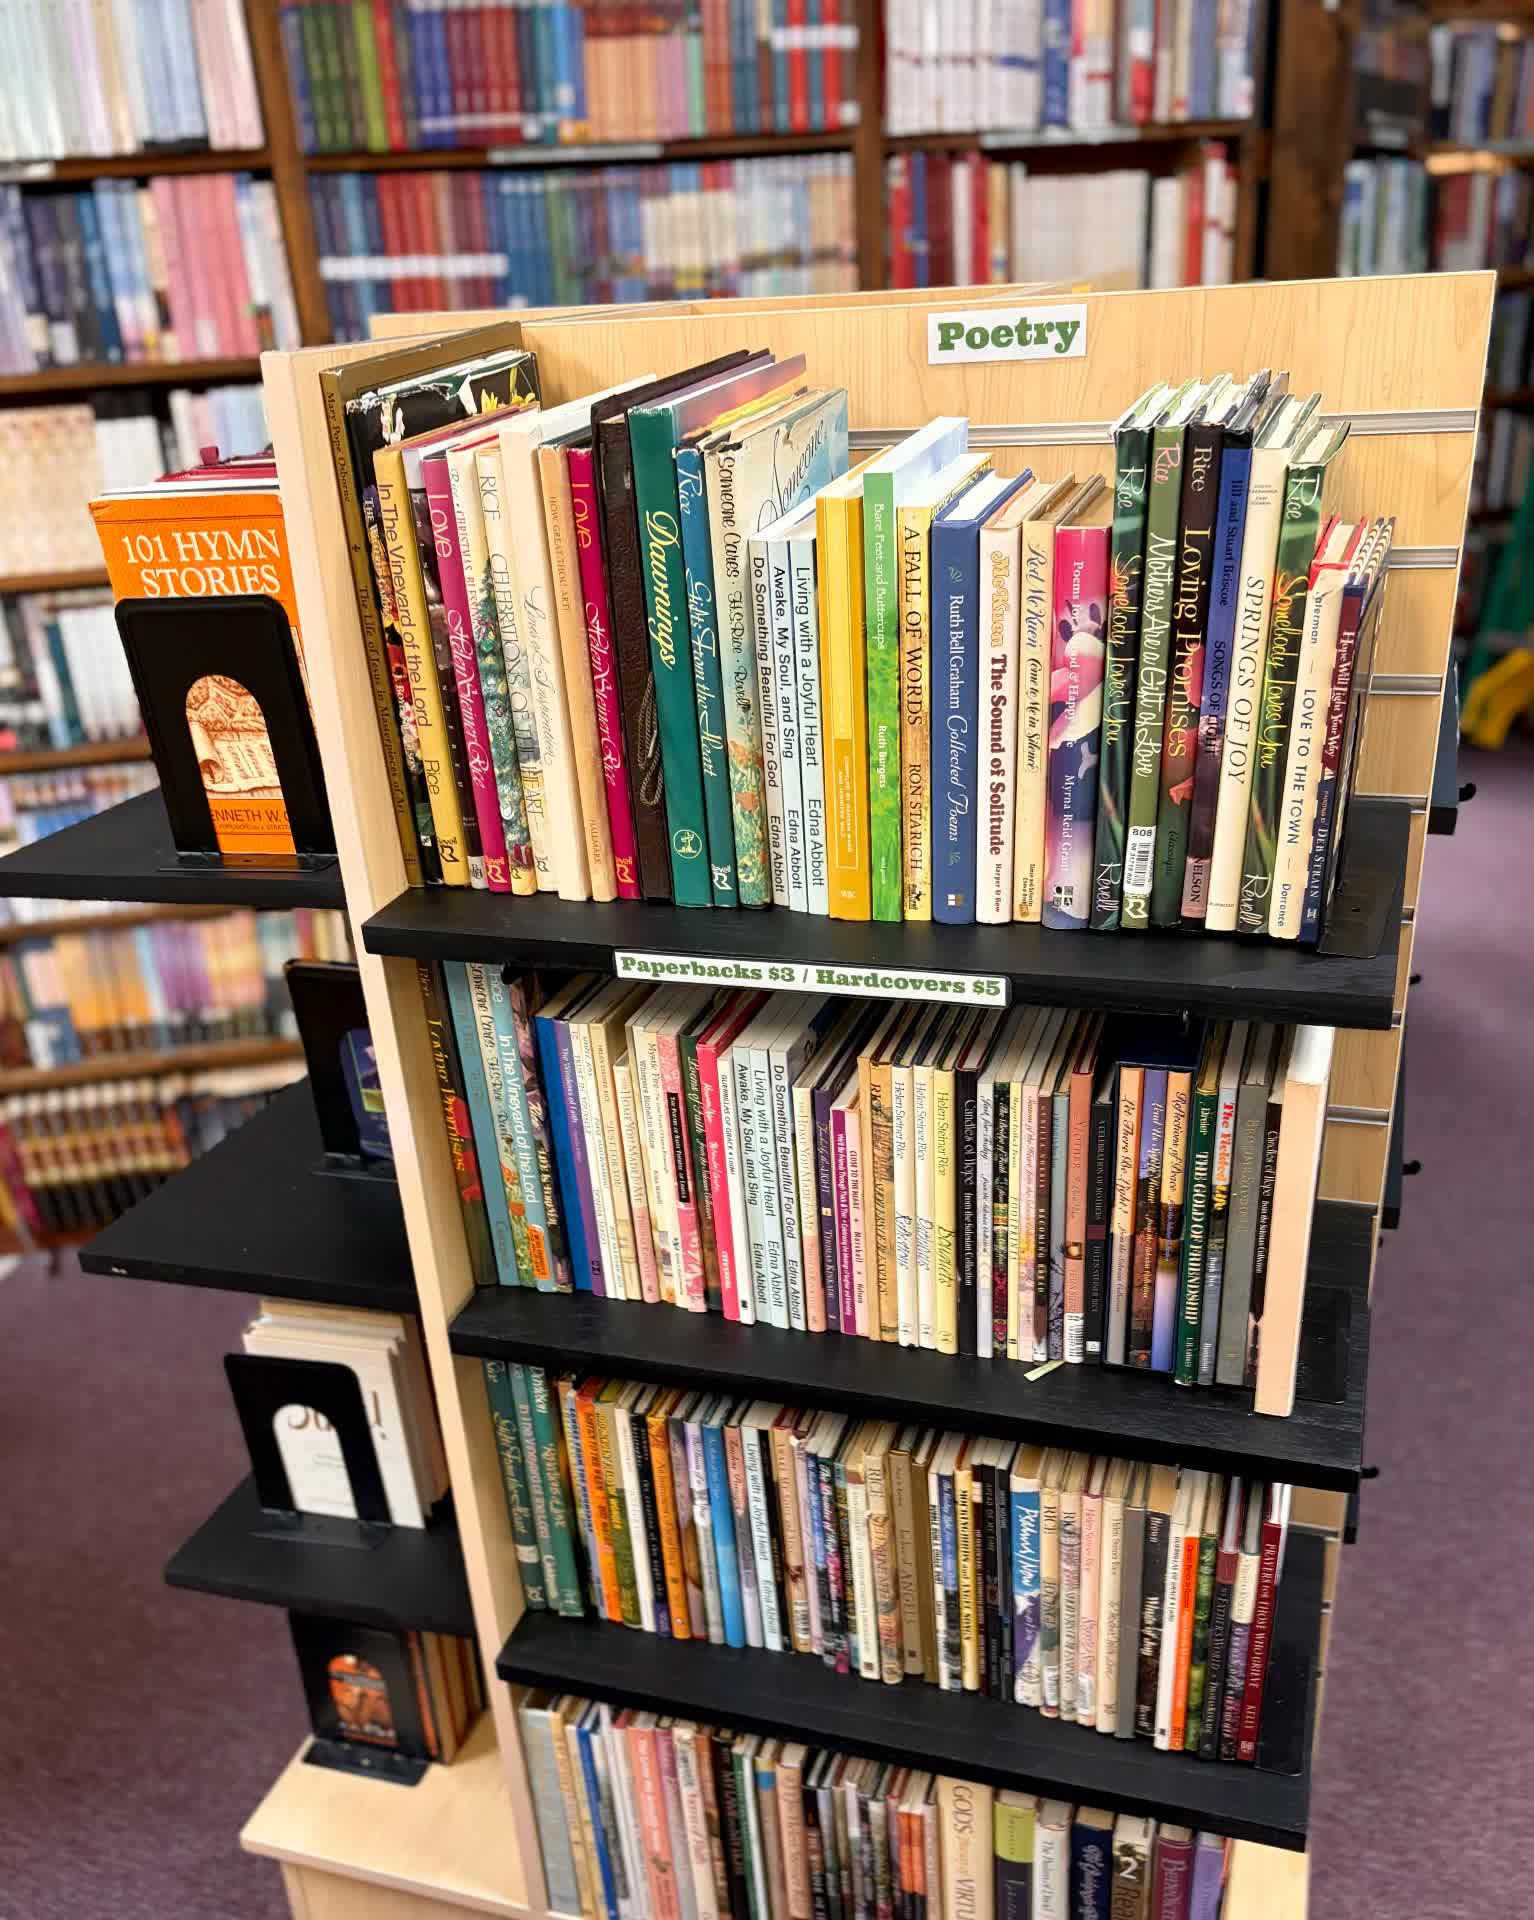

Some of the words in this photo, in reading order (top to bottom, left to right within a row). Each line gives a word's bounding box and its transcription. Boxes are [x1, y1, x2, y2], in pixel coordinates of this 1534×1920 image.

[938, 317, 1081, 353] Poetry
[327, 392, 336, 421] Mary
[330, 425, 341, 453] Pope
[337, 457, 352, 502] Osborne
[1153, 442, 1180, 484] Rice
[1192, 446, 1213, 492] Rice
[379, 484, 393, 500] In
[678, 468, 703, 514] Rice
[718, 456, 738, 528] Someone
[1117, 464, 1146, 508] Rice
[1286, 473, 1320, 520] Rice
[383, 504, 400, 542] The
[427, 494, 452, 557] Love
[873, 504, 885, 531] Bare
[904, 526, 921, 542] A
[121, 535, 163, 564] 101
[171, 528, 281, 562] HYMN
[723, 532, 741, 577] Cares
[874, 535, 886, 561] Feet
[140, 565, 281, 598] STORIES
[390, 545, 416, 627] Vineyard
[753, 558, 765, 578] Do
[875, 563, 888, 585] and
[904, 551, 921, 603] FALL
[1146, 532, 1176, 612] Mothers
[1173, 525, 1212, 622] Loving
[645, 510, 680, 670] Dawnings
[684, 568, 711, 629] Gifts
[773, 567, 787, 621] Awake,
[793, 567, 810, 615] Living
[1107, 552, 1142, 647] Somebody
[755, 583, 771, 660] Something
[871, 588, 887, 649] Buttercups
[905, 611, 922, 641] OF
[949, 595, 965, 627] Ruth
[1267, 572, 1309, 669] Somebody
[403, 632, 417, 651] of
[447, 610, 472, 676] Helen
[775, 628, 789, 648] My
[799, 621, 815, 653] with
[949, 630, 965, 654] Bell
[1143, 611, 1171, 650] Are
[1238, 576, 1264, 688] SPRINGS
[1340, 632, 1355, 661] Hope
[408, 655, 423, 684] the
[693, 627, 715, 680] From
[801, 658, 811, 668] a
[1143, 652, 1158, 665] a
[734, 666, 751, 713] Revell
[778, 655, 792, 691] Soul,
[905, 647, 923, 726] WORDS
[949, 655, 964, 709] Graham
[991, 654, 1007, 691] The
[1107, 648, 1135, 697] Loves
[1137, 667, 1166, 712] Gift
[1337, 661, 1351, 684] Will
[412, 687, 432, 727] Lord
[458, 680, 479, 738] Steiner
[696, 683, 715, 711] the
[760, 667, 774, 728] Beautiful
[781, 696, 793, 722] and
[799, 673, 817, 720] Joyful
[1168, 630, 1202, 757] Promises
[1264, 673, 1297, 720] Loves
[1300, 689, 1317, 729] LOVE
[1331, 687, 1348, 711] Light
[990, 695, 1006, 753] Sound
[1104, 701, 1130, 745] You
[1135, 712, 1163, 727] of
[1233, 698, 1252, 731] OF
[1330, 713, 1343, 735] Your
[699, 711, 723, 777] Heart
[765, 733, 777, 757] For
[782, 727, 795, 759] Sing
[805, 725, 820, 767] Heart
[878, 725, 887, 749] Ruth
[947, 715, 968, 790] Collected
[1134, 728, 1161, 777] Love
[1258, 725, 1289, 769] You
[1297, 738, 1311, 756] TO
[1325, 734, 1340, 757] Way
[425, 760, 440, 795] Rice
[467, 741, 490, 789] Rice
[767, 760, 779, 788] God
[877, 751, 889, 788] Burgess
[990, 758, 1005, 777] of
[1227, 735, 1248, 784] JOY
[909, 764, 922, 797] RON
[1293, 766, 1307, 791] THE
[770, 815, 781, 849] Edna
[788, 810, 799, 843] Edna
[808, 799, 822, 836] Edna
[909, 801, 923, 870] STARICH
[947, 792, 969, 842] Poems
[990, 782, 1005, 855] Solitude
[1287, 799, 1304, 844] TOWN
[1315, 828, 1329, 852] DEB
[772, 851, 785, 893] Abbott
[790, 846, 802, 889] Abbott
[810, 840, 824, 886] Abbott
[1310, 855, 1324, 898] STRAIN
[1096, 861, 1123, 912] Revell
[1240, 872, 1272, 924] Revell
[1277, 883, 1292, 926] Dorrance
[620, 956, 762, 982] Paperbacks
[768, 967, 795, 982] $3
[802, 968, 809, 983] /
[816, 969, 965, 993] Hardcovers
[972, 979, 1001, 997] $5
[499, 1035, 513, 1047] In
[502, 1049, 517, 1075] The
[738, 1064, 751, 1104] Awake,
[507, 1077, 528, 1133] Vineyard
[741, 1108, 753, 1124] My
[937, 1092, 949, 1121] Helen
[964, 1099, 975, 1142] Candles
[1122, 1094, 1136, 1117] Let
[517, 1136, 529, 1150] of
[743, 1128, 754, 1155] Soul,
[938, 1122, 948, 1155] Steiner
[964, 1144, 976, 1154] of
[1122, 1119, 1134, 1153] There
[519, 1152, 532, 1172] the
[746, 1159, 757, 1178] and
[939, 1156, 949, 1176] Rice
[1121, 1156, 1133, 1174] Be
[1194, 1151, 1209, 1181] THE
[523, 1175, 539, 1203] Lord
[747, 1182, 759, 1206] Sing
[1191, 1183, 1208, 1221] GOLD
[1190, 1224, 1205, 1243] OF
[753, 1243, 764, 1269] Edna
[755, 1271, 766, 1303] Abbott
[1185, 1244, 1203, 1324] FRIENDSHIP
[1261, 1543, 1277, 1583] PRAYERS
[1255, 1601, 1271, 1630] THOSE
[1253, 1633, 1267, 1656] WHO
[1249, 1656, 1264, 1688] GRIEVE
[1244, 1705, 1257, 1729] KELLY
